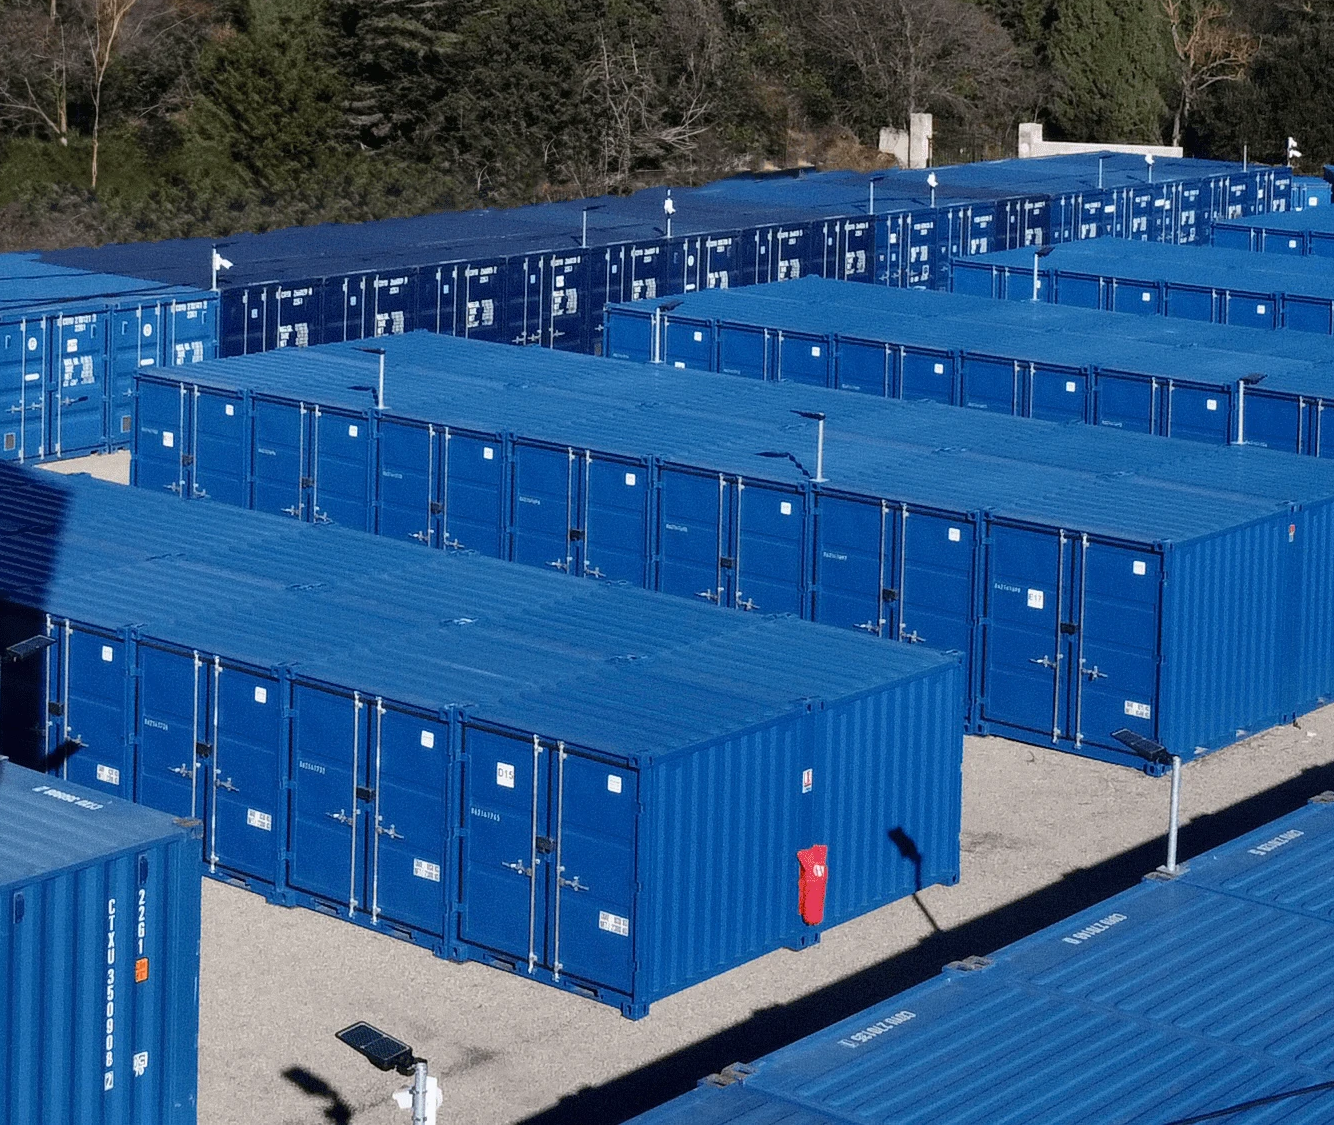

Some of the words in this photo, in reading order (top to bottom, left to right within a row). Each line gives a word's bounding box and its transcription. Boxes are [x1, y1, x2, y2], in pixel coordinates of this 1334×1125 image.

[498, 767, 514, 780] D15
[107, 898, 116, 965] CTXU
[137, 888, 147, 955] 22G1
[105, 968, 115, 1068] 350908
